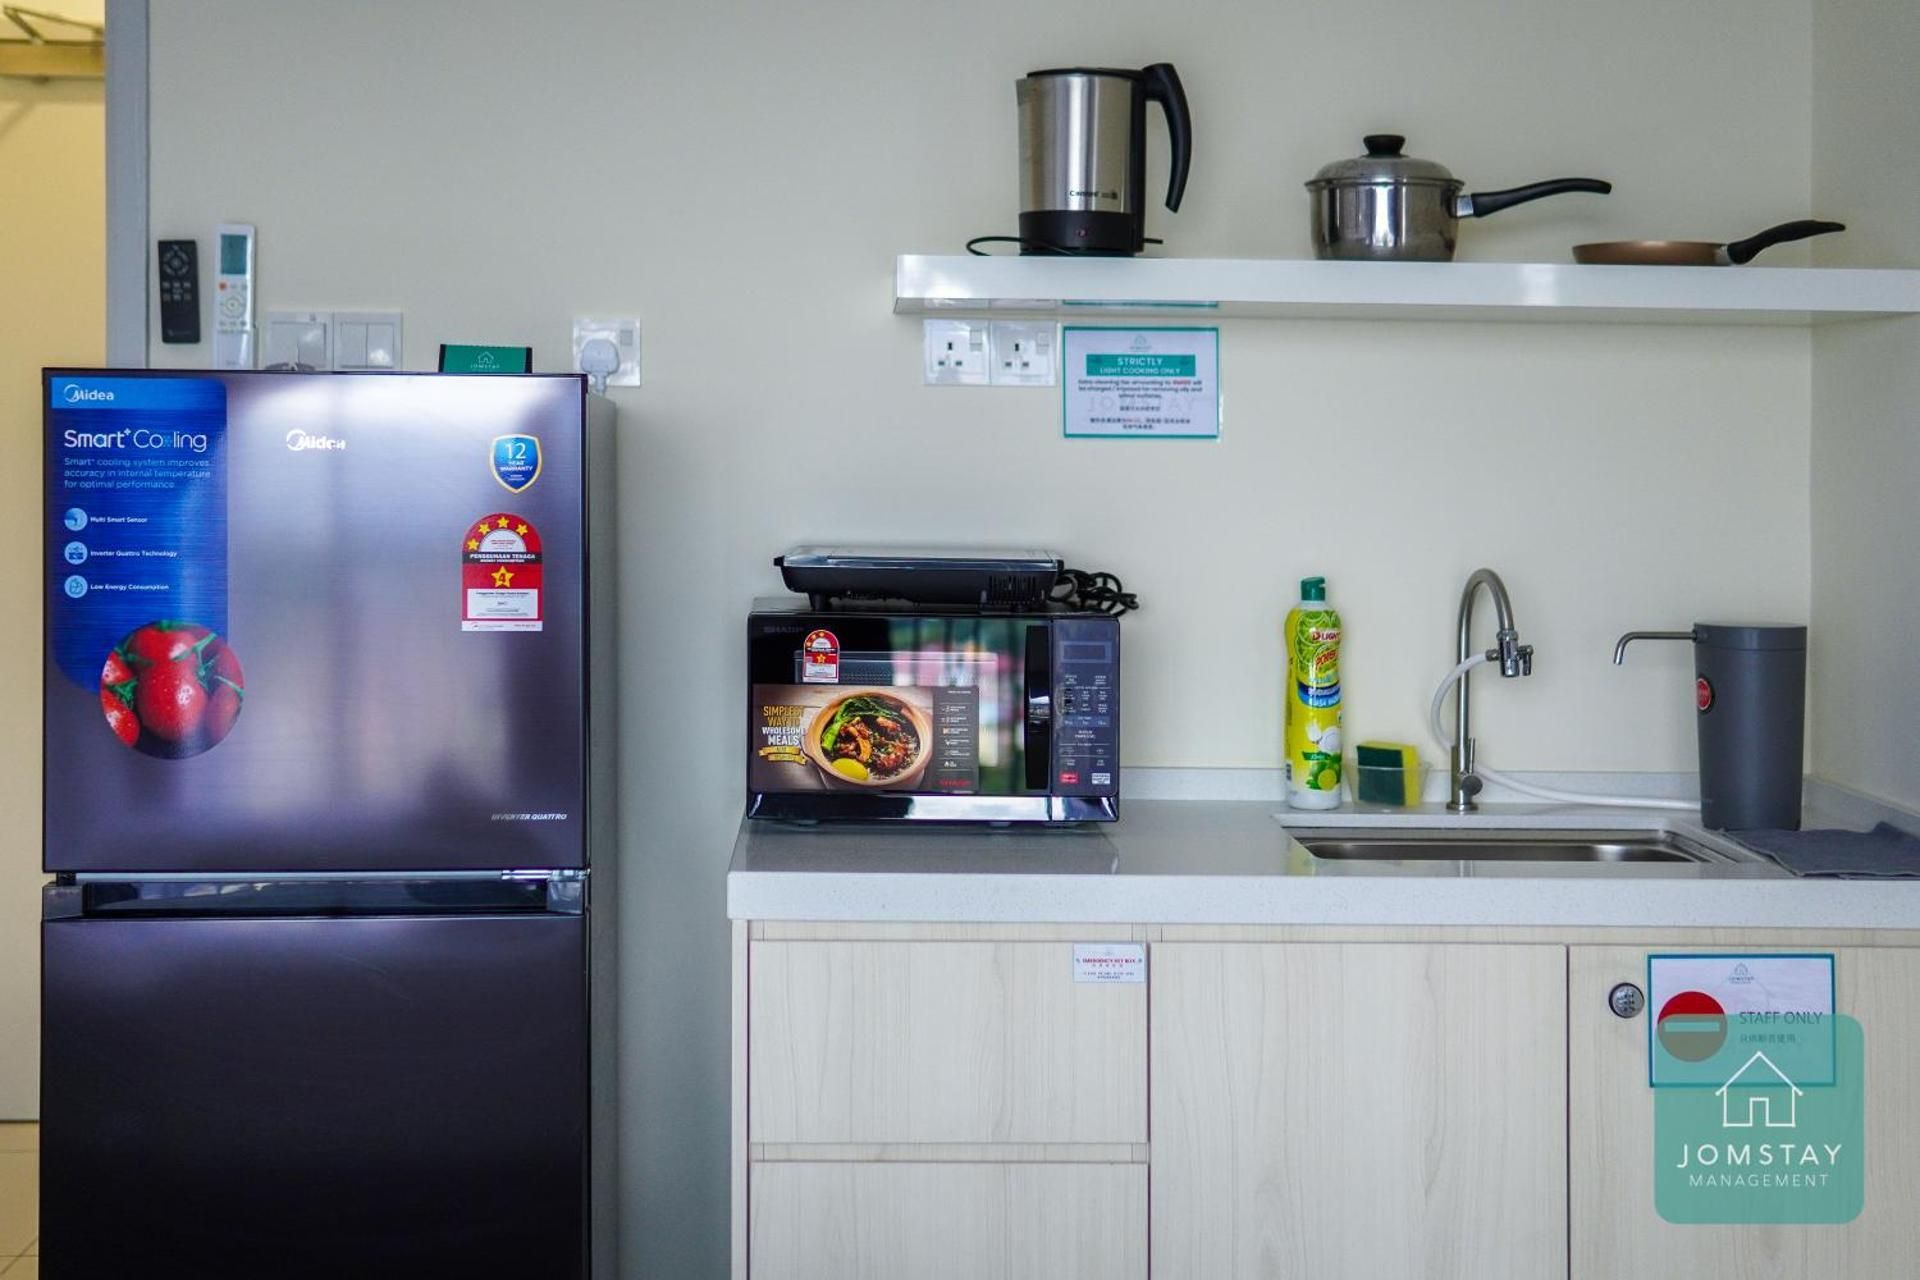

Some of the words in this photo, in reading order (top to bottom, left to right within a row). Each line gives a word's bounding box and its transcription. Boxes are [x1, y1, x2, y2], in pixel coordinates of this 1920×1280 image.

[1117, 357, 1163, 367] STRICTLY
[1122, 367, 1159, 375] COOKING
[1160, 367, 1181, 375] ONLY
[64, 384, 115, 403] Midea
[506, 442, 526, 459] 12
[97, 458, 131, 468] cooling
[132, 459, 164, 468] system
[166, 460, 210, 469] improves
[64, 469, 106, 479] accuracy
[107, 469, 117, 478] in
[118, 468, 153, 478] internal
[154, 469, 211, 480] temperature
[64, 479, 77, 488] for
[79, 479, 115, 490] optimal
[105, 583, 127, 591] Energy
[767, 735, 800, 746] MEALS
[530, 813, 568, 821] QUATTRO
[1740, 1011, 1780, 1025] STAFF
[1783, 1011, 1823, 1025] ONLY
